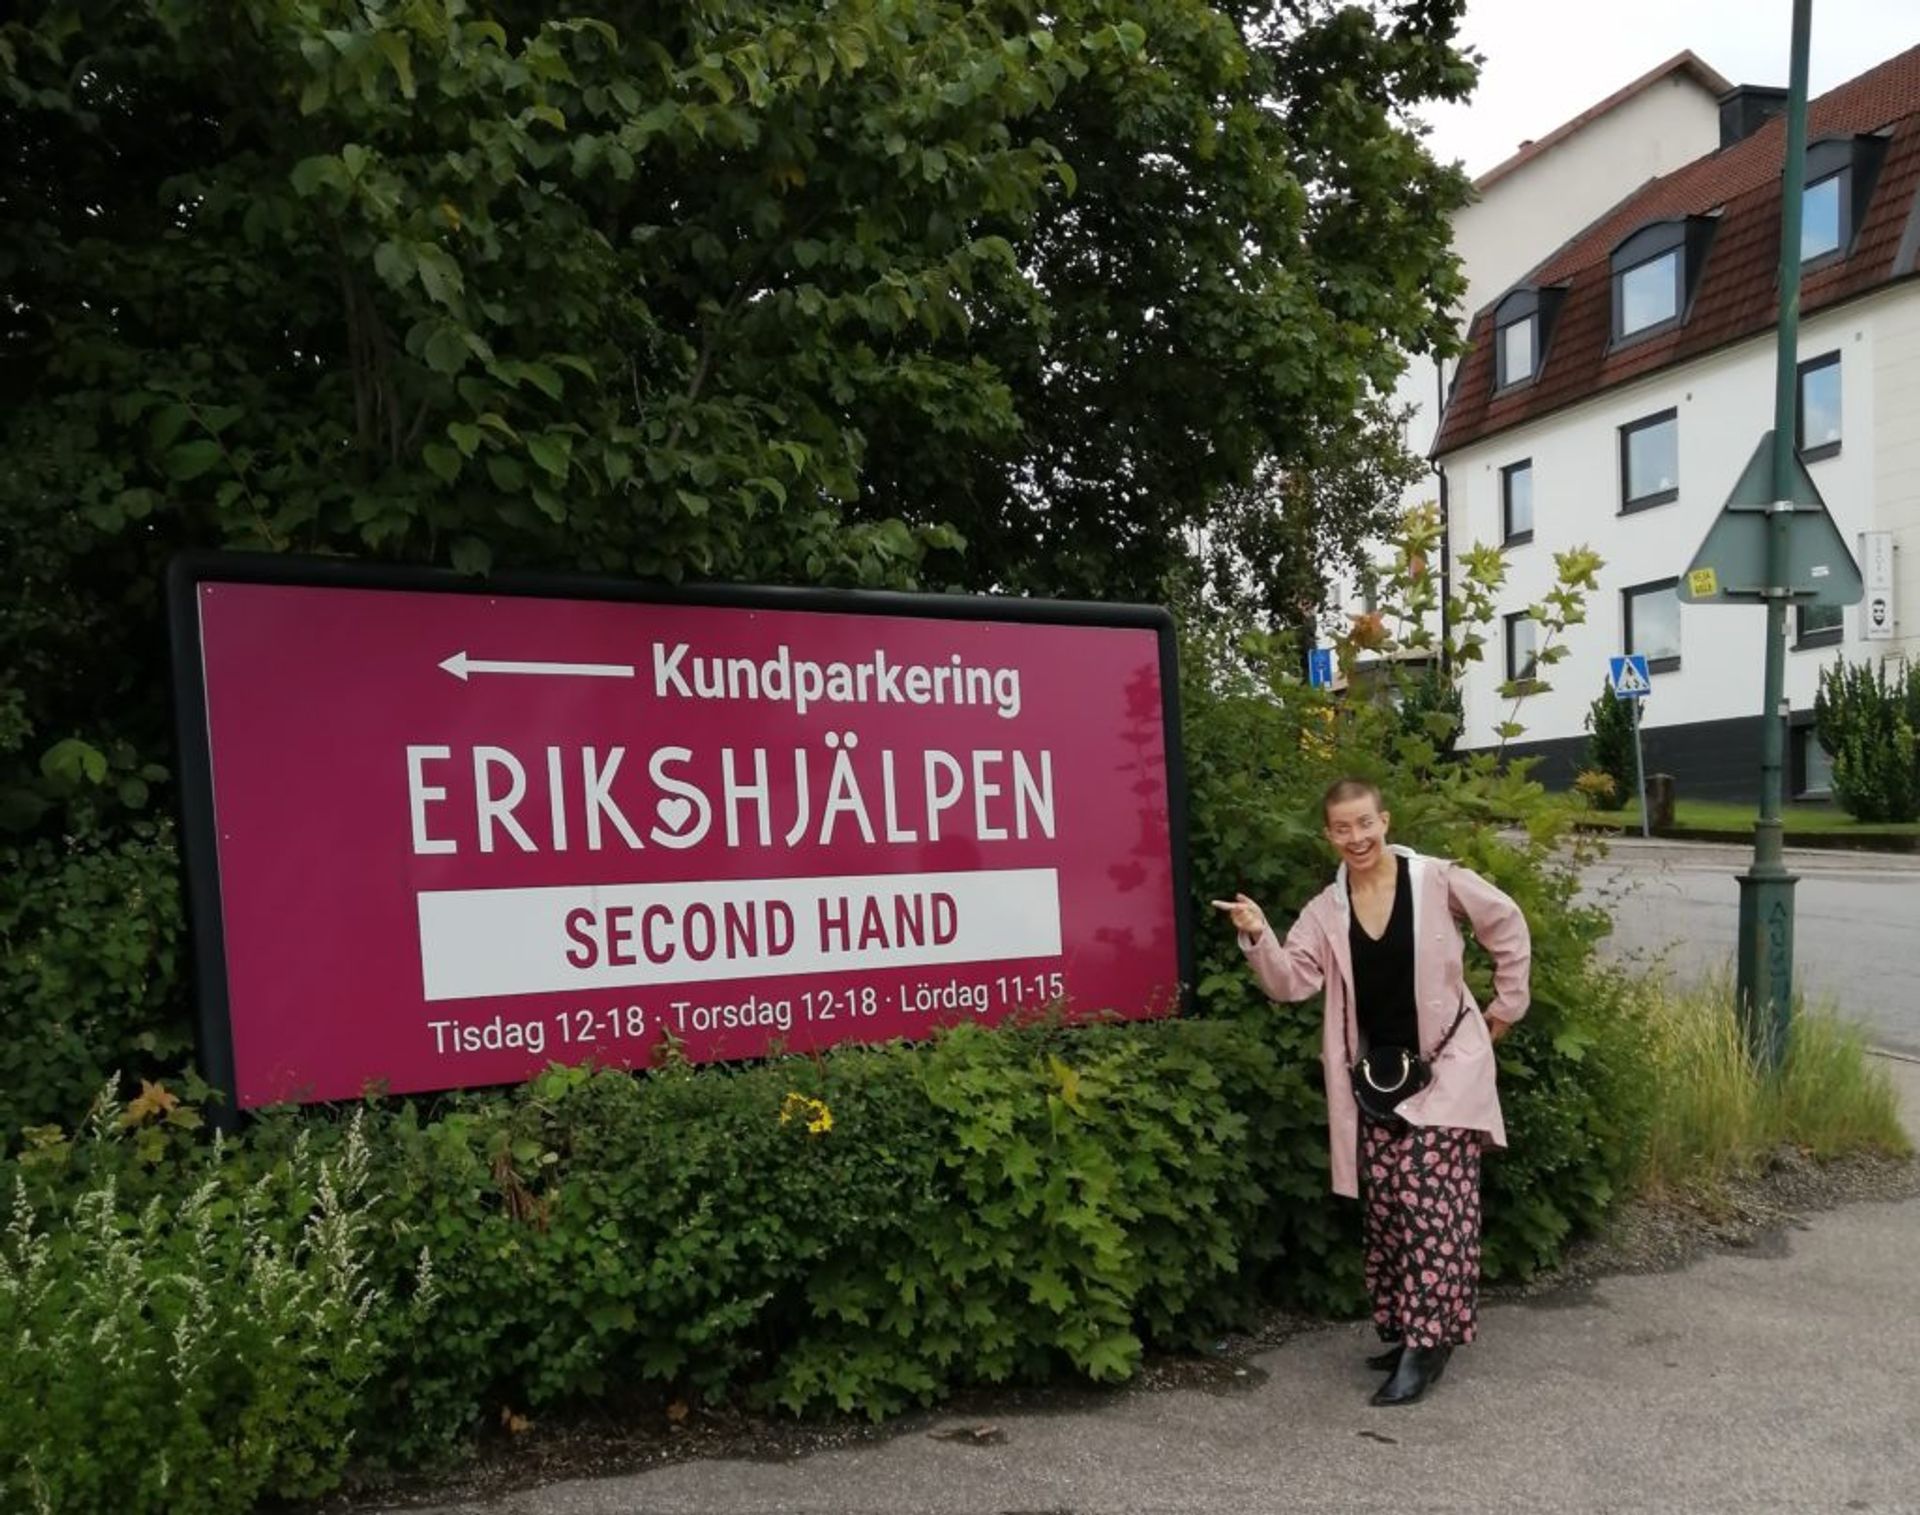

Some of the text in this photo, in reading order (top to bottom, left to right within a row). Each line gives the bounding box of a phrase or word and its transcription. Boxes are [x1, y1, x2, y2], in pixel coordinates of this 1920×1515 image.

[653, 643, 1021, 718] Kundparkering
[406, 731, 1056, 855] ERIKSHJÄLPEN
[566, 893, 958, 969] SECOND HAND
[428, 1015, 545, 1053] Tisdag
[556, 1007, 645, 1042] 12-18
[671, 995, 792, 1032] Torsdag
[801, 988, 877, 1019] 12-18
[900, 979, 989, 1012] Lördag
[996, 972, 1064, 1004] 11-15
